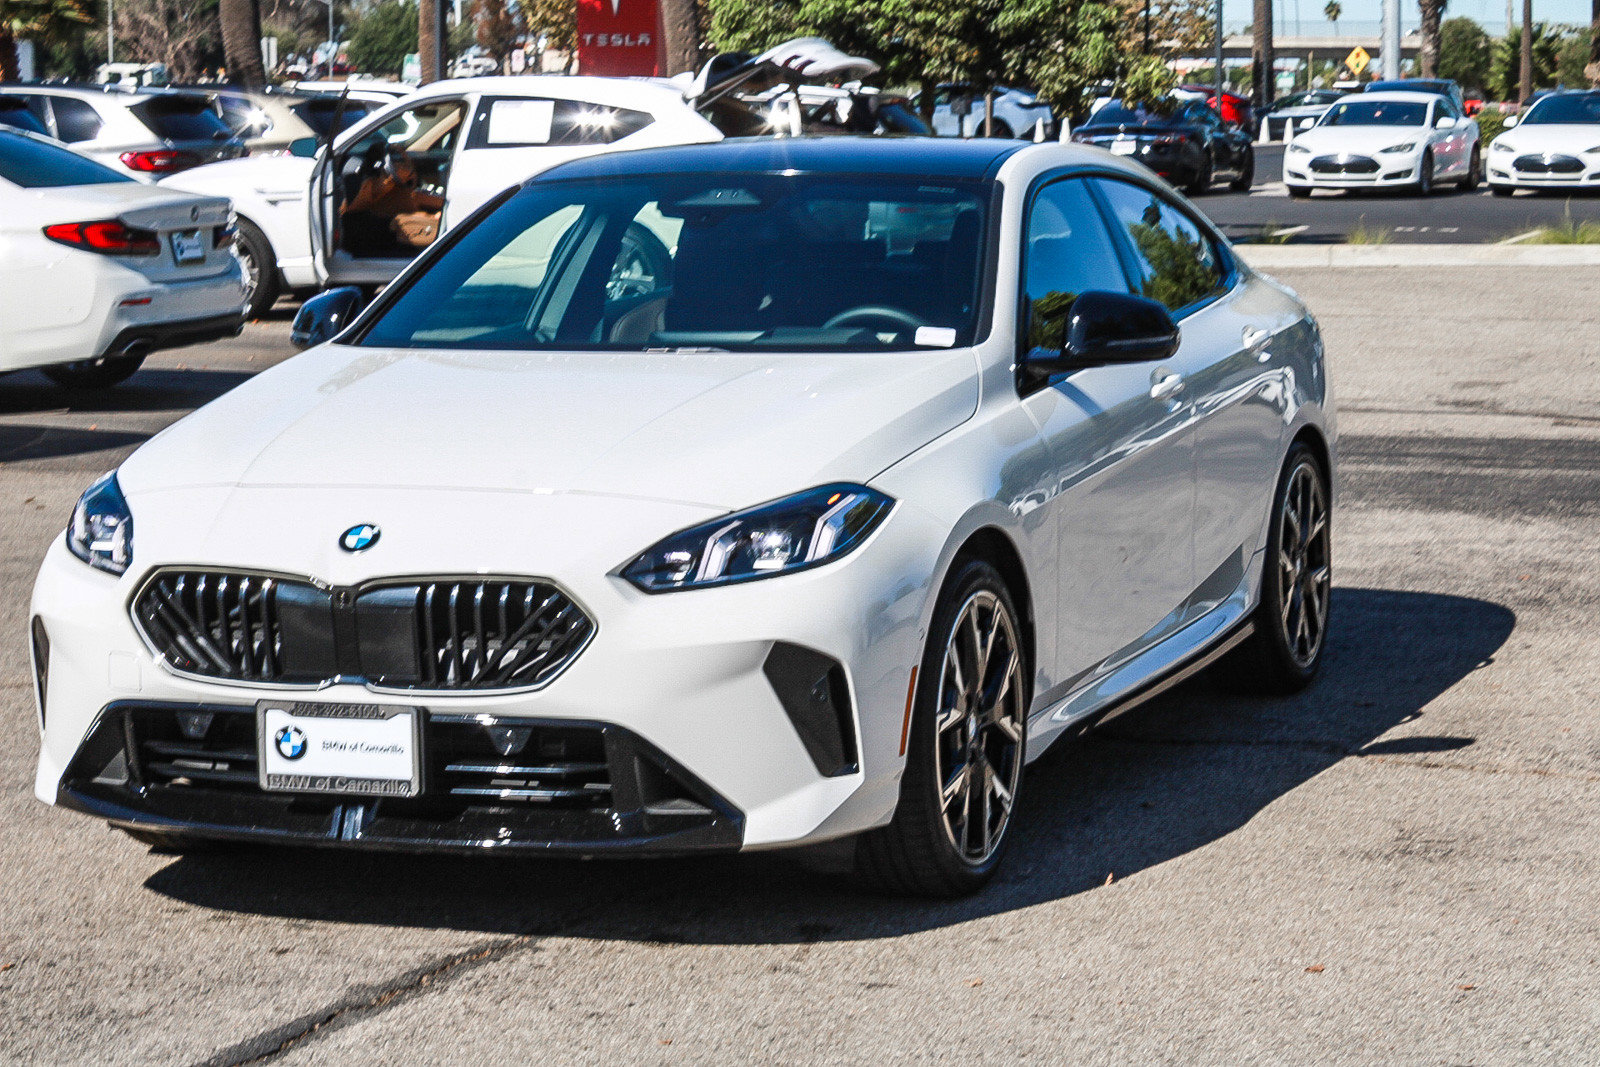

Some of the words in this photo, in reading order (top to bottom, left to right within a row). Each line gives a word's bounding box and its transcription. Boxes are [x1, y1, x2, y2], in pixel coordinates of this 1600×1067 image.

[583, 33, 651, 46] TESLA
[322, 740, 347, 751] BMW
[268, 774, 311, 790] BMW
[315, 776, 331, 791] of
[334, 776, 410, 796] Camarillo
